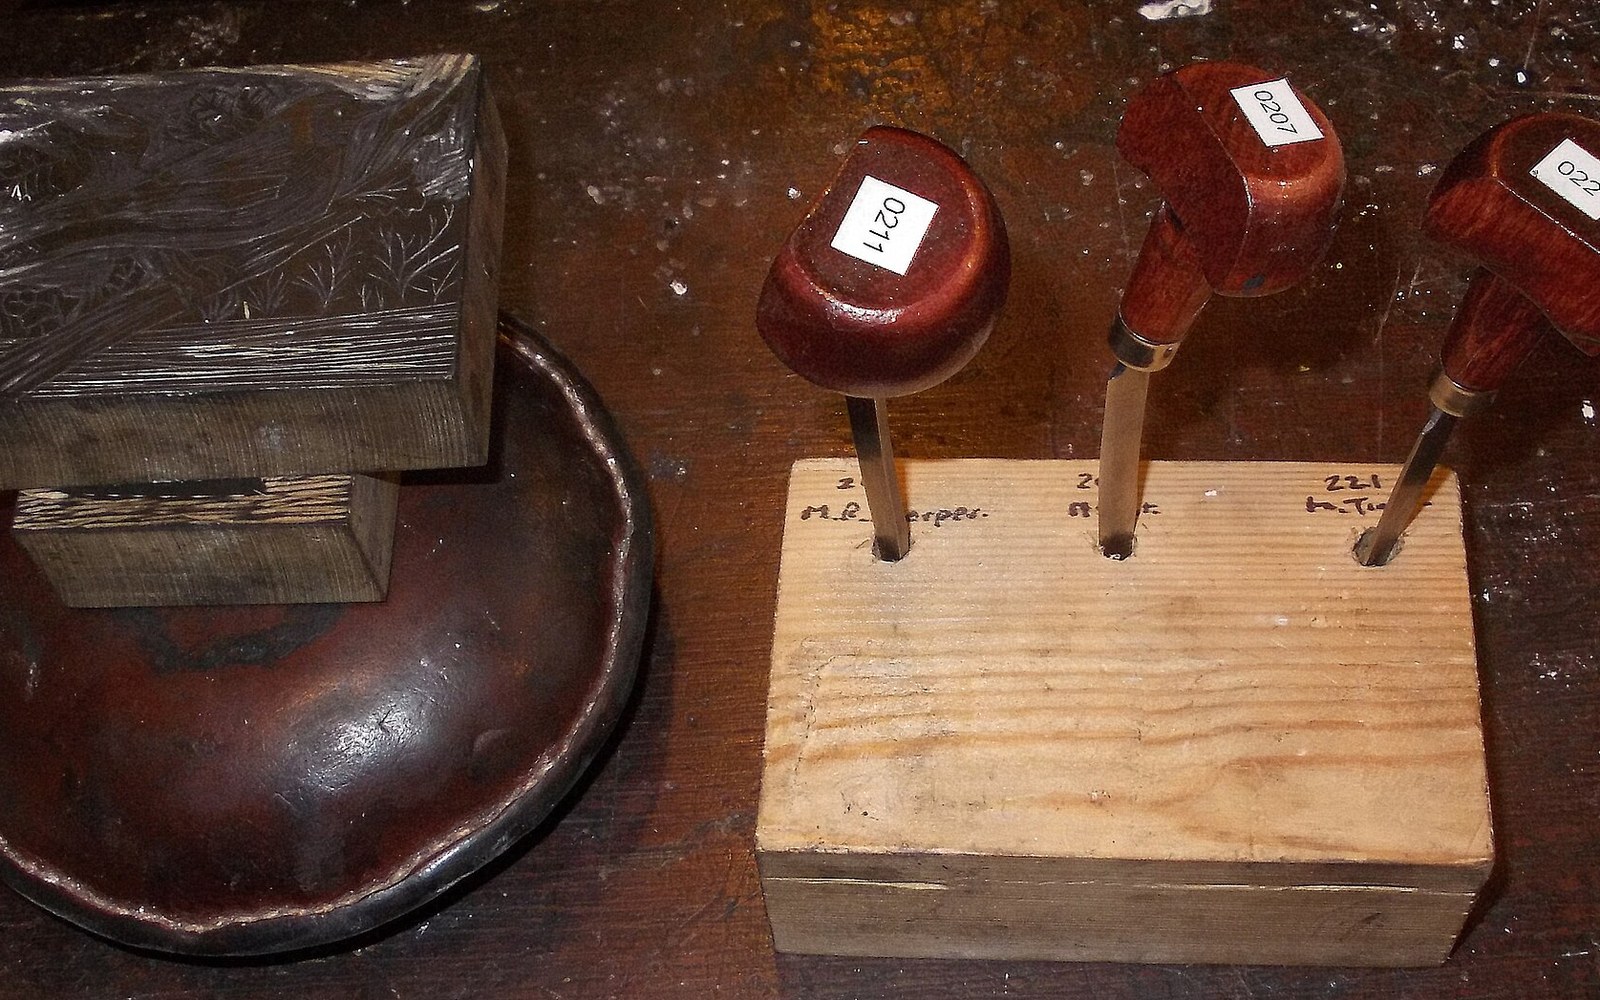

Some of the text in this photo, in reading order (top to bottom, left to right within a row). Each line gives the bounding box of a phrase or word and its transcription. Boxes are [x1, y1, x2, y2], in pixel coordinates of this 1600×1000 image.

[1254, 90, 1298, 134] 0207
[1558, 161, 1600, 196] 022
[863, 197, 906, 253] 0211
[1324, 474, 1382, 491] 221
